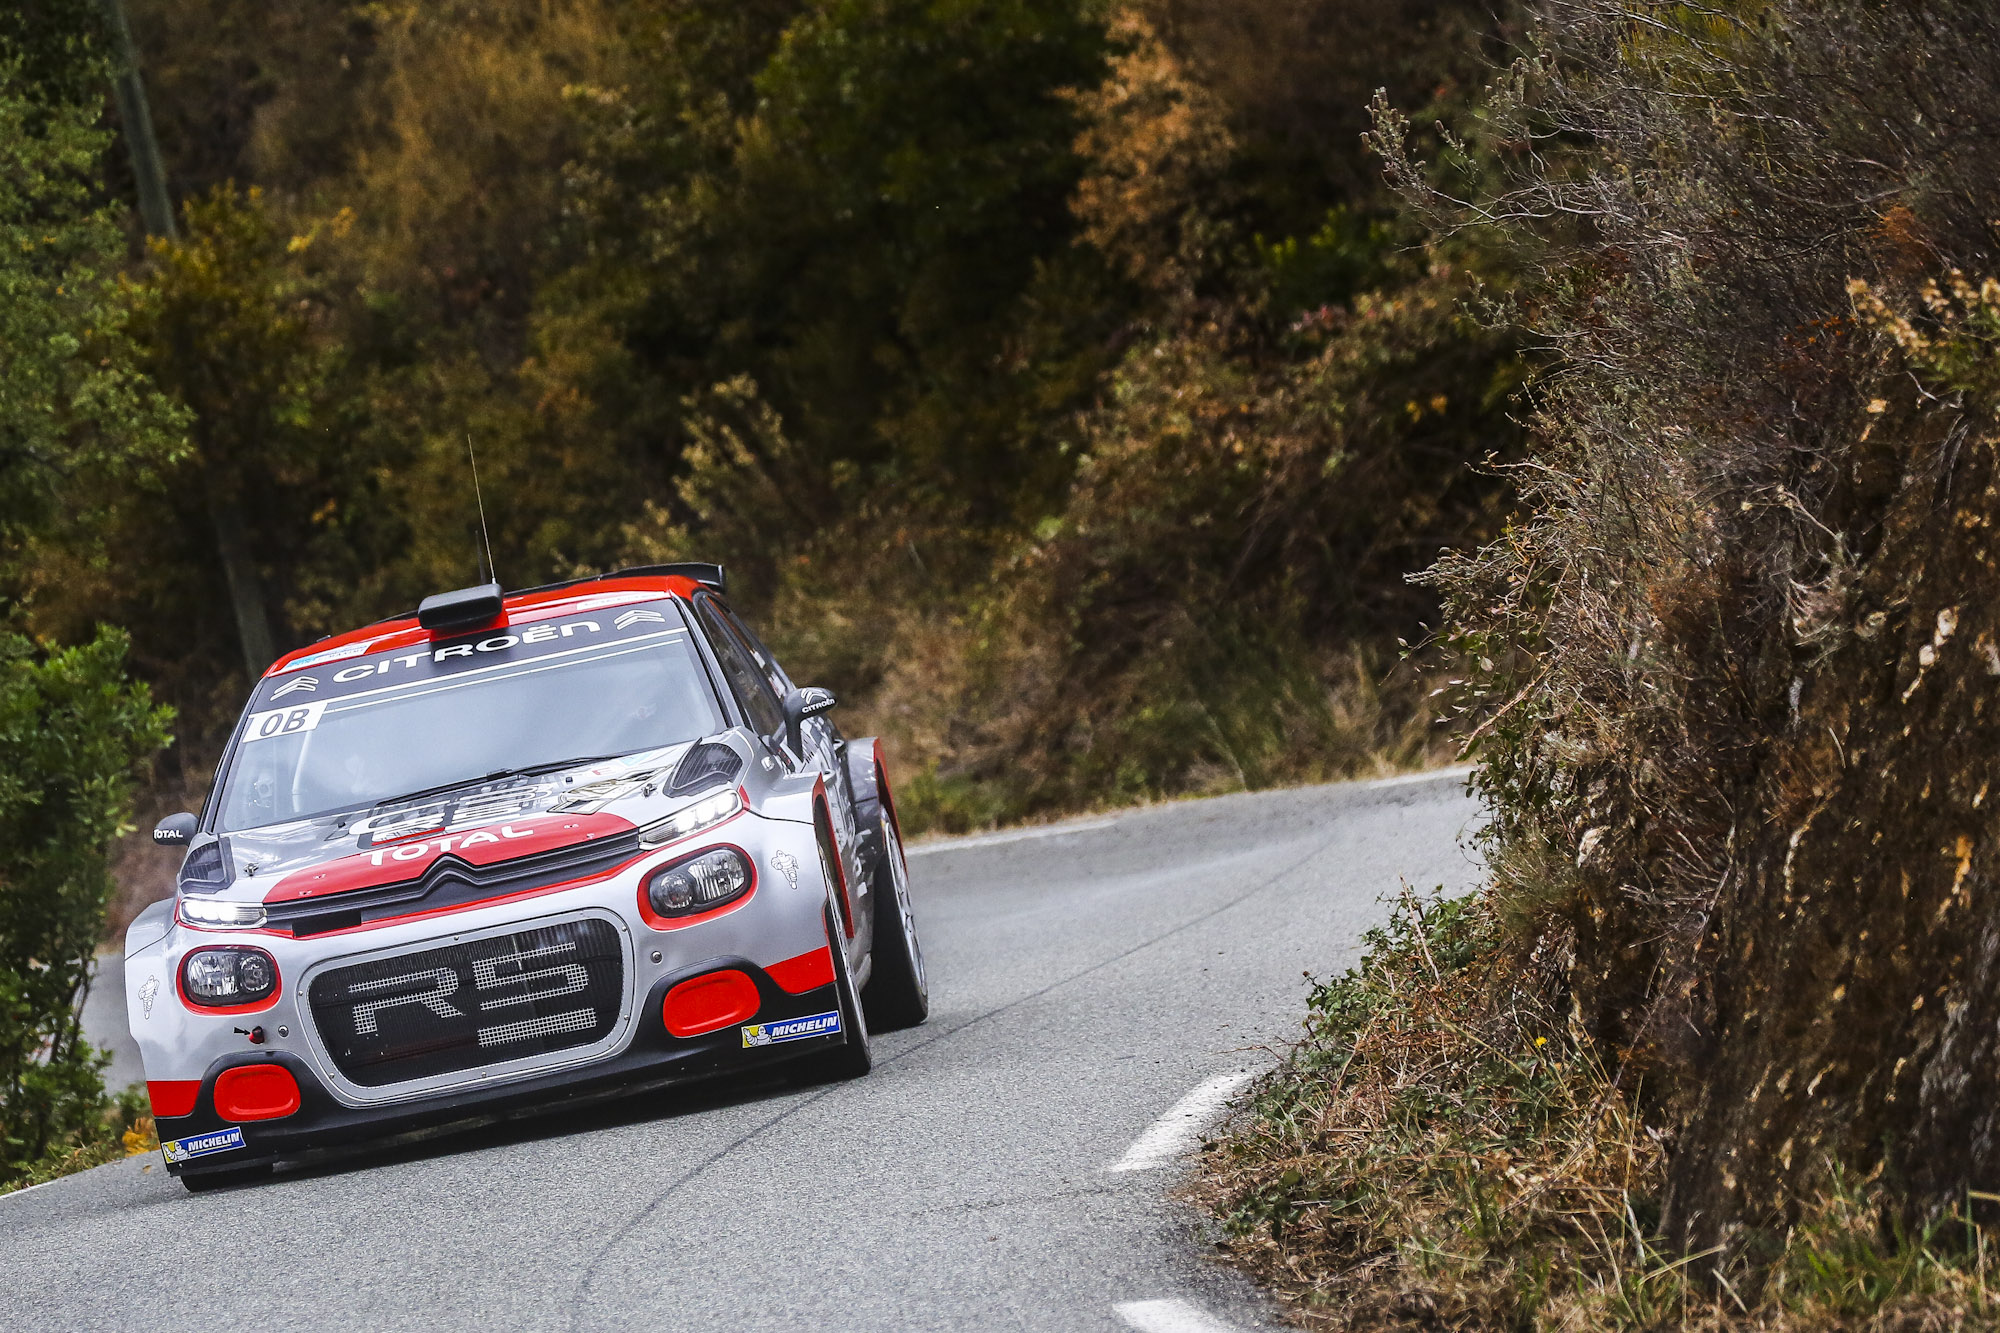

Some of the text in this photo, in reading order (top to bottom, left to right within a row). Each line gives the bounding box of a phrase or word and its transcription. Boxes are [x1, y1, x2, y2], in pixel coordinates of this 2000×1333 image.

[260, 708, 310, 736] 0B
[153, 829, 183, 839] TOTAL
[360, 826, 534, 866] TOTAL
[772, 1016, 837, 1036] MICHELIN
[187, 1132, 240, 1151] MICHELIN
